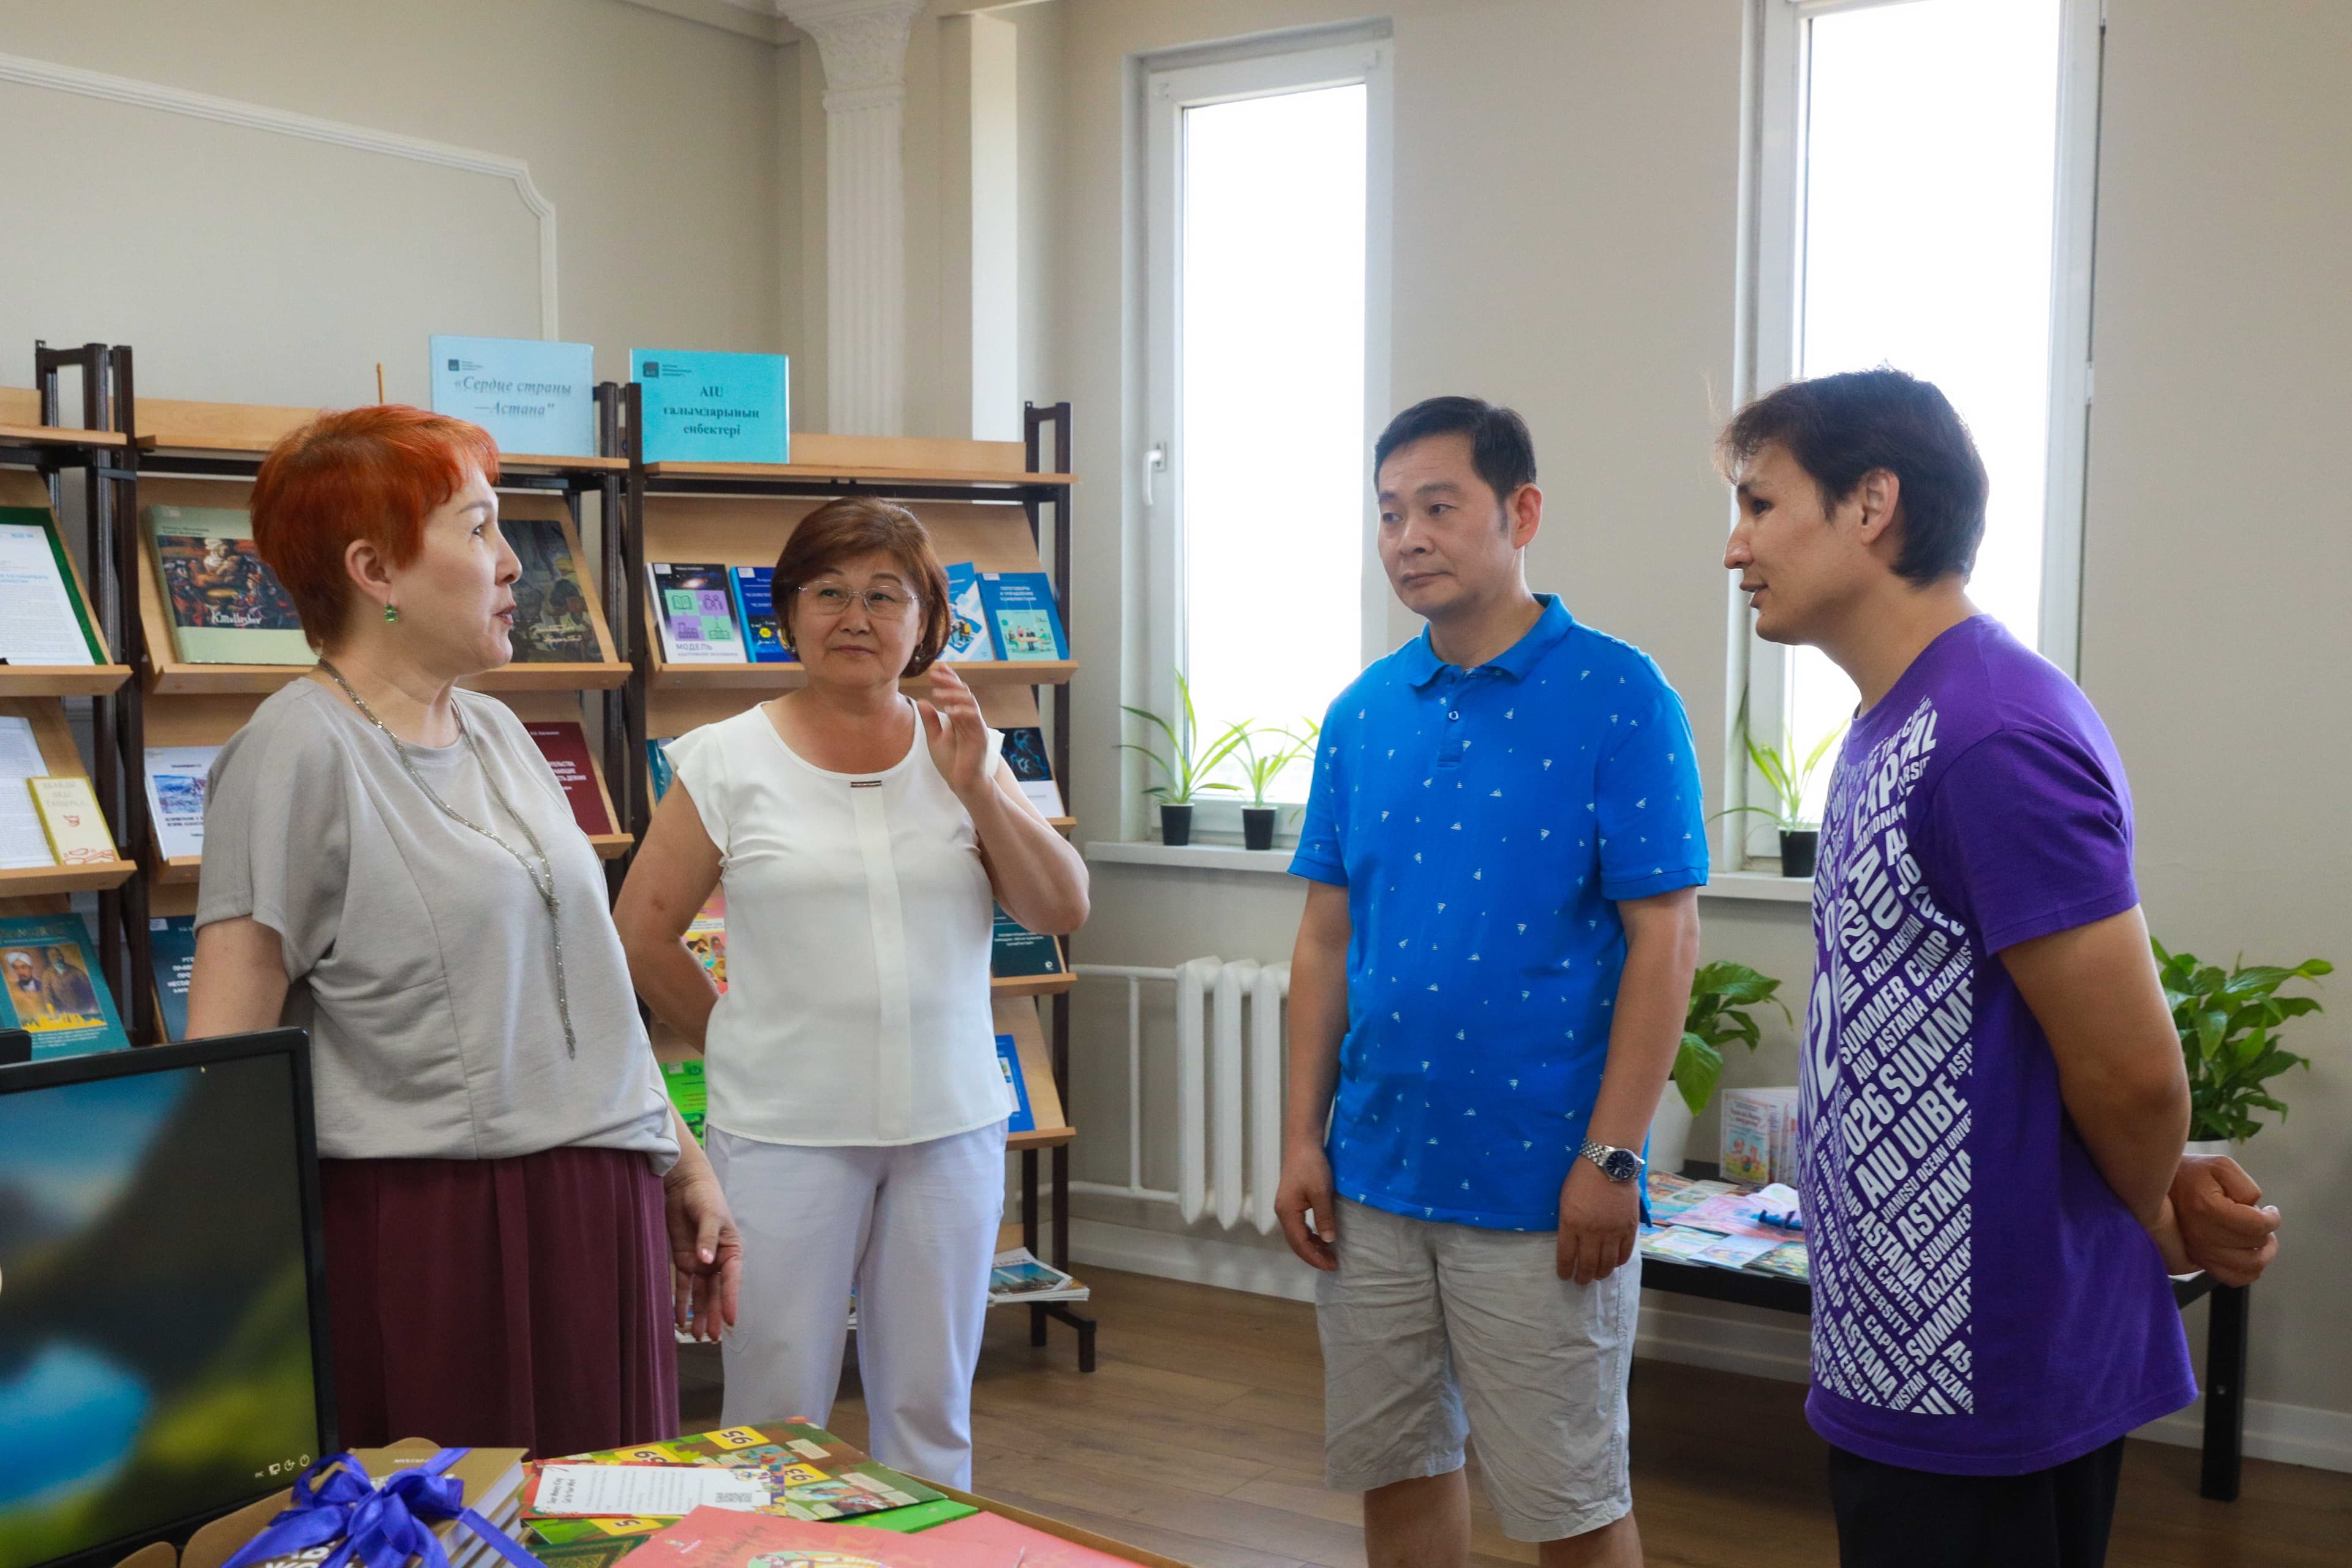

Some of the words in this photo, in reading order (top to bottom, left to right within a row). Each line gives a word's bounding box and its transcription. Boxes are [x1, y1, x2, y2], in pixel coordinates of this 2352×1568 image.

[517, 382, 571, 395] страны
[700, 386, 723, 397] AIU
[1848, 844, 1903, 930] AIU
[1839, 975, 1911, 1065] SUMMER
[1904, 930, 1951, 987] CAMP
[1851, 1048, 1879, 1085] AIU
[1874, 995, 1929, 1058] ASTANA
[1855, 1136, 1909, 1209] AIU
[1891, 1072, 1969, 1159] UIBE
[1880, 1176, 1921, 1224] JIANGSU
[1916, 1144, 1950, 1183] OCEAN
[1856, 1211, 1927, 1294] ASTANA
[1856, 1240, 1880, 1270] THE
[1875, 1266, 1924, 1322] CAPITAL
[1819, 1248, 1845, 1308] CAMP
[1841, 1310, 1899, 1401] ASTANA
[1847, 1283, 1867, 1317] THE
[1864, 1314, 1915, 1379] CAPITAL
[1849, 1257, 1913, 1336] UNIVERSITY
